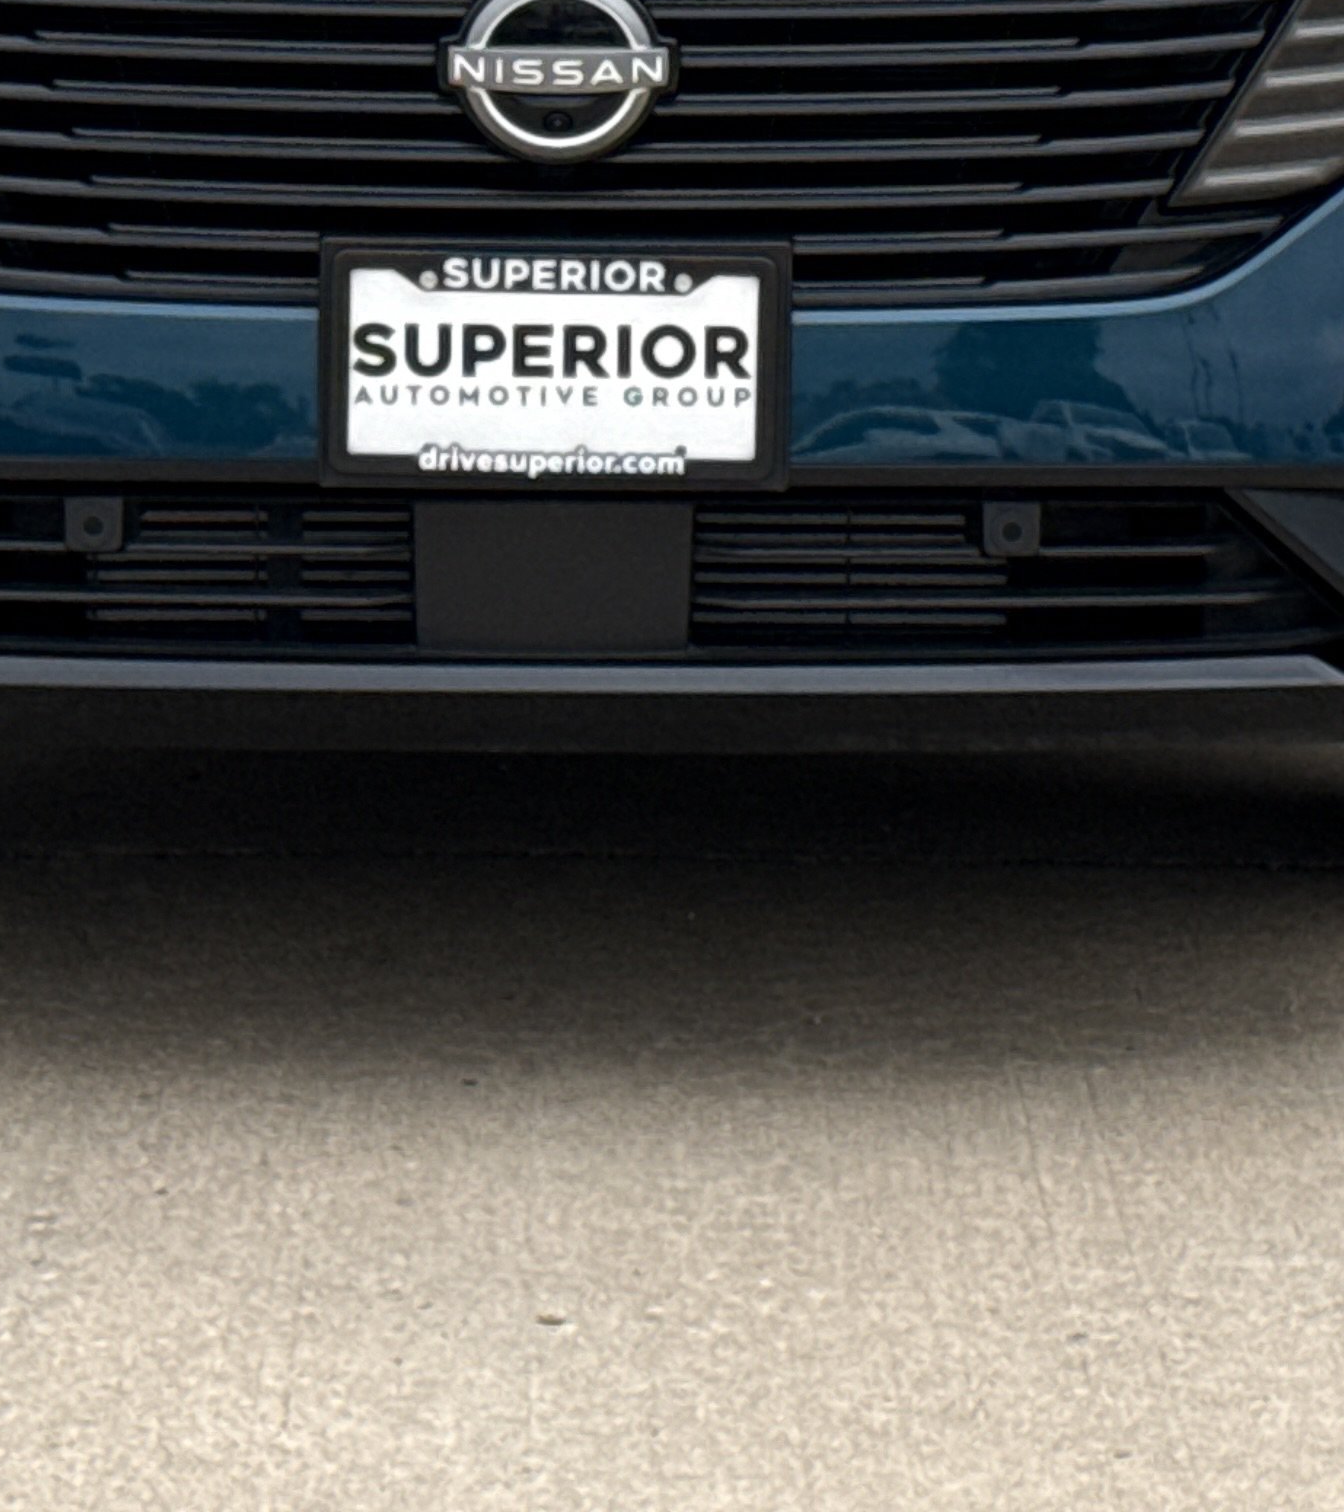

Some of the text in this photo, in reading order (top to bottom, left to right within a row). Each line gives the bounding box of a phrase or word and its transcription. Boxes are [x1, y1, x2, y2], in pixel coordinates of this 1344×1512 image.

[453, 54, 663, 85] NISSAN
[442, 257, 666, 292] SUPERIOR
[353, 322, 751, 380] SUPERIOR
[354, 385, 752, 408] AUTOMOTIVE GROUP
[419, 447, 686, 479] drivesuperior.com
